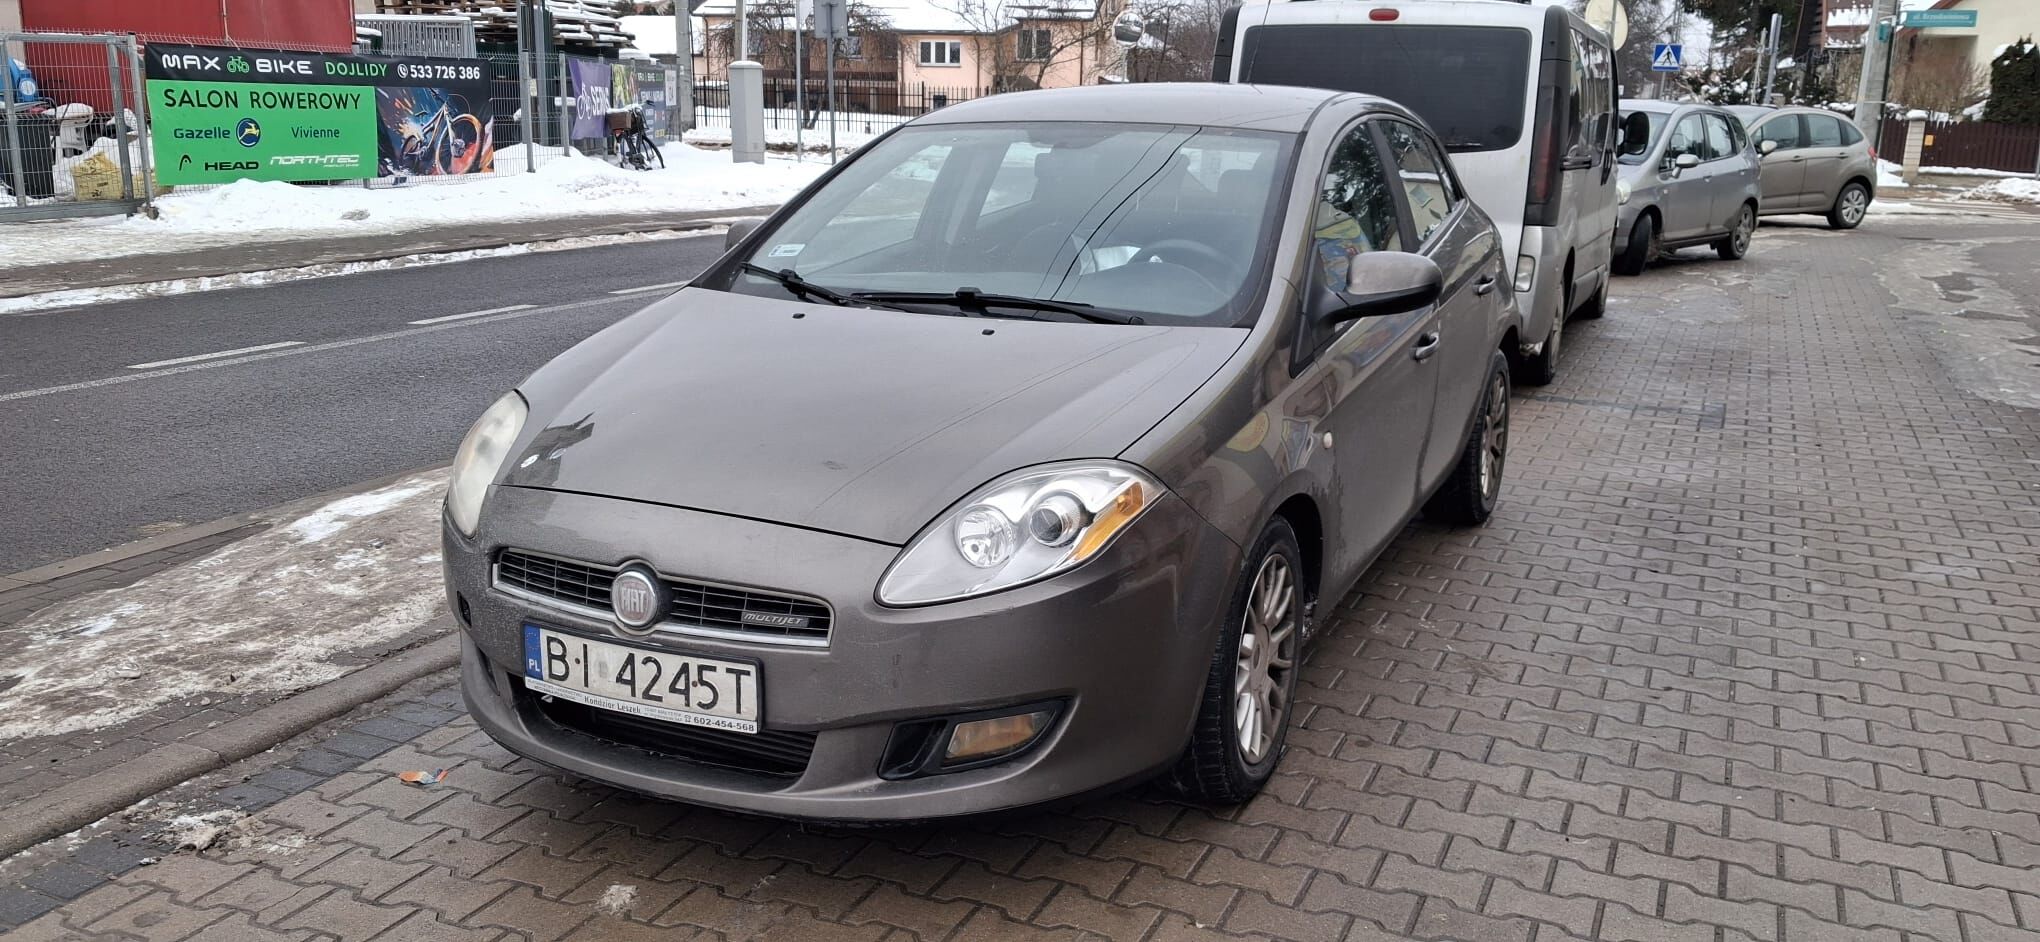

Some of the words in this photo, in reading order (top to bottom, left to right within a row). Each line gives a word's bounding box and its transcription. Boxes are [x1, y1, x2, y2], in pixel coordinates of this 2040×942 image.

[161, 54, 221, 71] MAX
[256, 58, 313, 74] BIKE
[325, 62, 387, 77] DOJLIDY
[410, 64, 433, 79] 533
[435, 65, 456, 79] 726
[459, 66, 480, 80] 386
[164, 88, 239, 108] SALON
[250, 91, 361, 110] ROWEROWY
[173, 127, 231, 139] Gazelle
[291, 126, 340, 139] Vivienne
[204, 161, 259, 171] HEAD
[270, 154, 360, 165] NORTHTEC
[621, 587, 646, 613] FIAT
[744, 613, 804, 625] MULTIJET
[528, 658, 541, 672] PL
[615, 652, 751, 714] 4245T
[693, 716, 755, 732] 602-454-568
